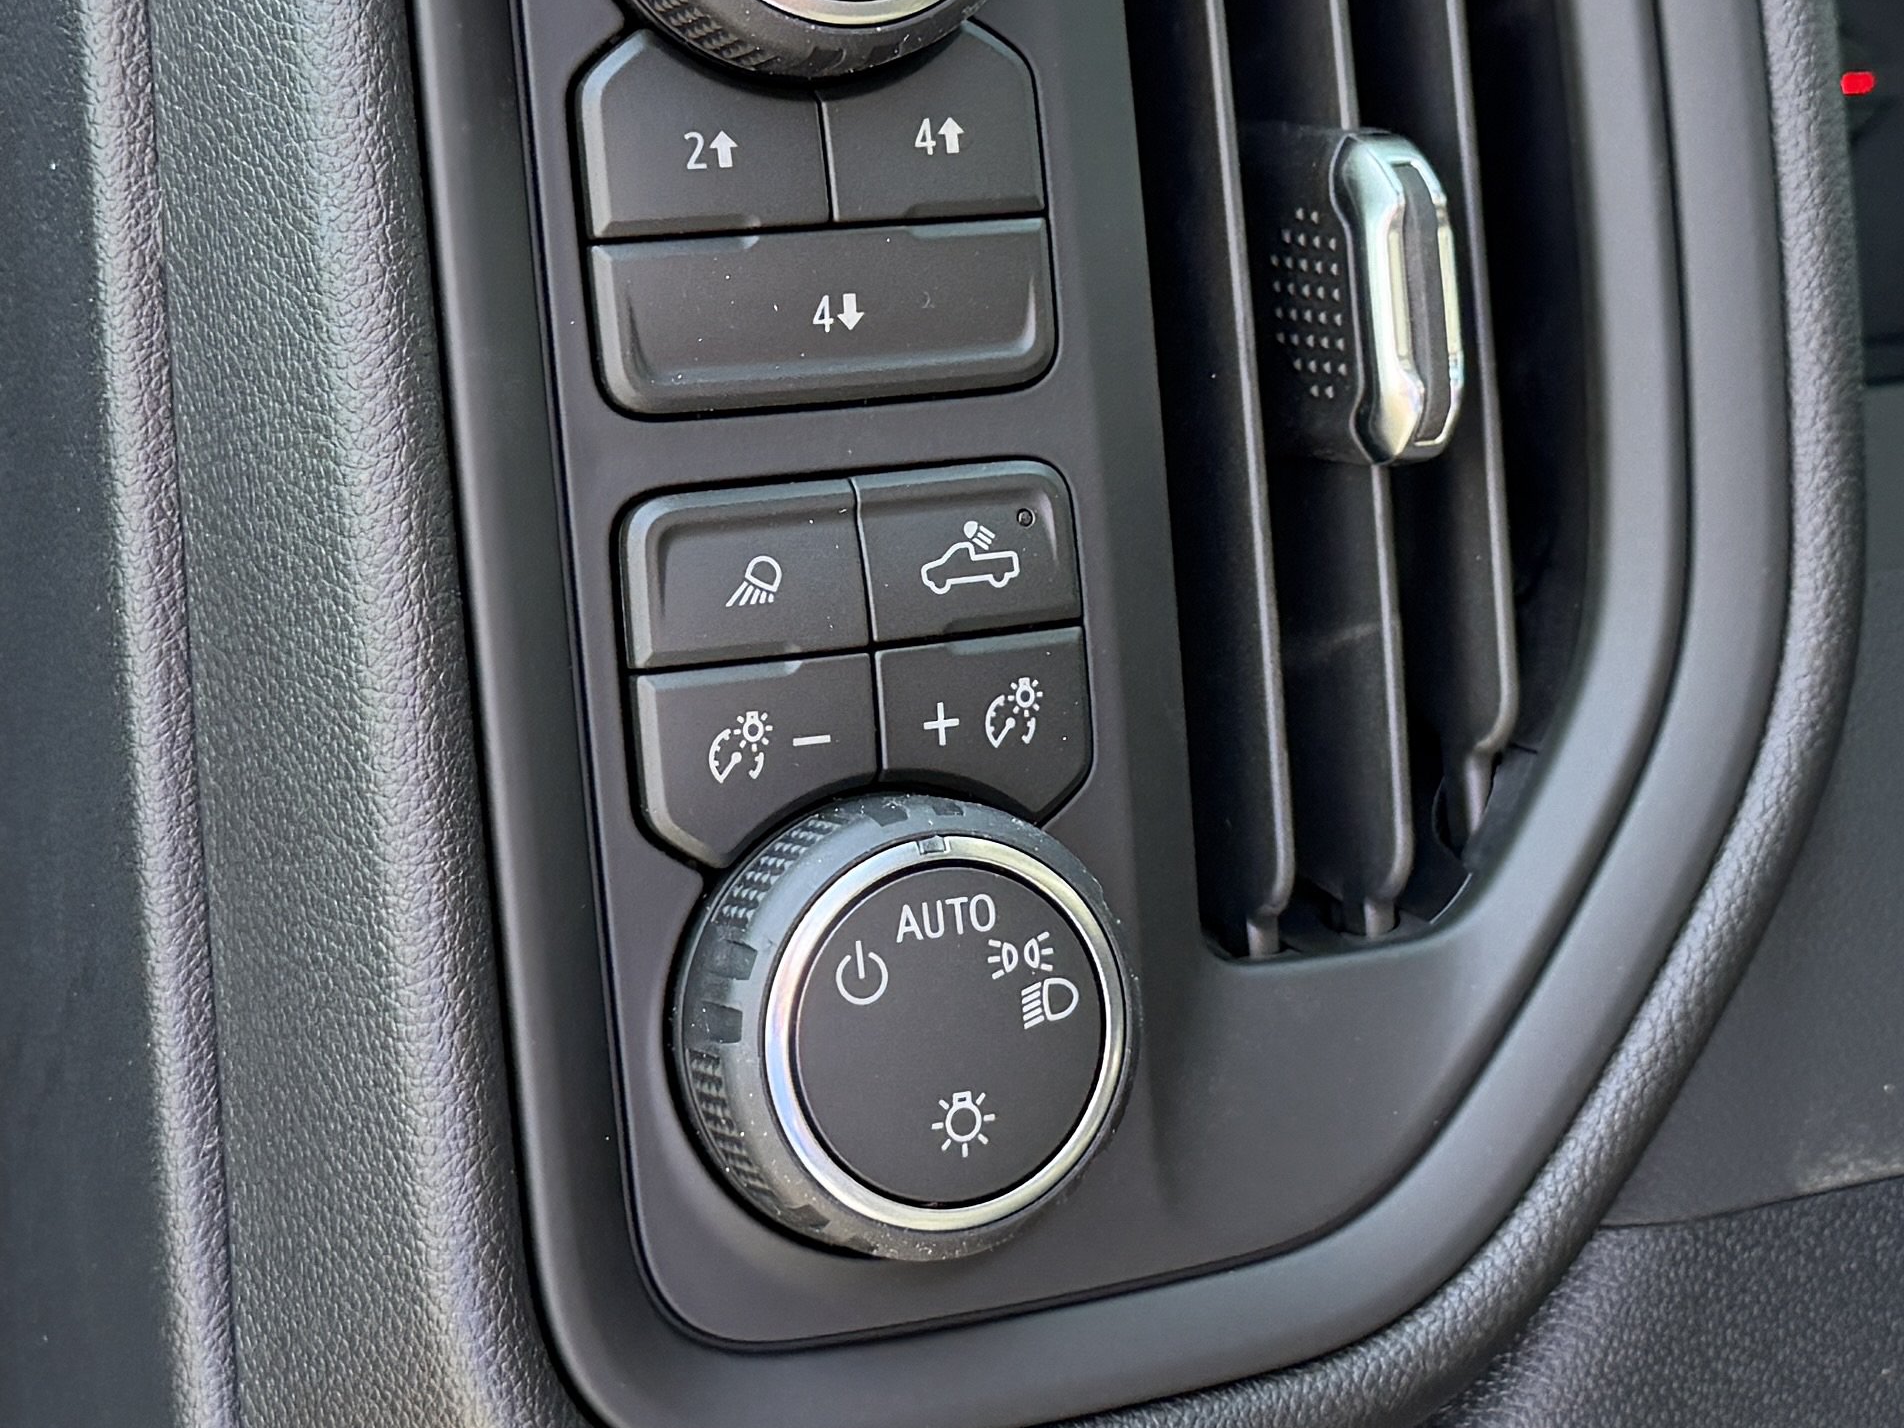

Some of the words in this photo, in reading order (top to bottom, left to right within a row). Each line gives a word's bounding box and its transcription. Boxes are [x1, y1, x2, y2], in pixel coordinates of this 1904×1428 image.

[683, 130, 708, 170] 2
[913, 117, 937, 156] 4
[812, 294, 835, 334] 4
[895, 892, 997, 944] AUTO
